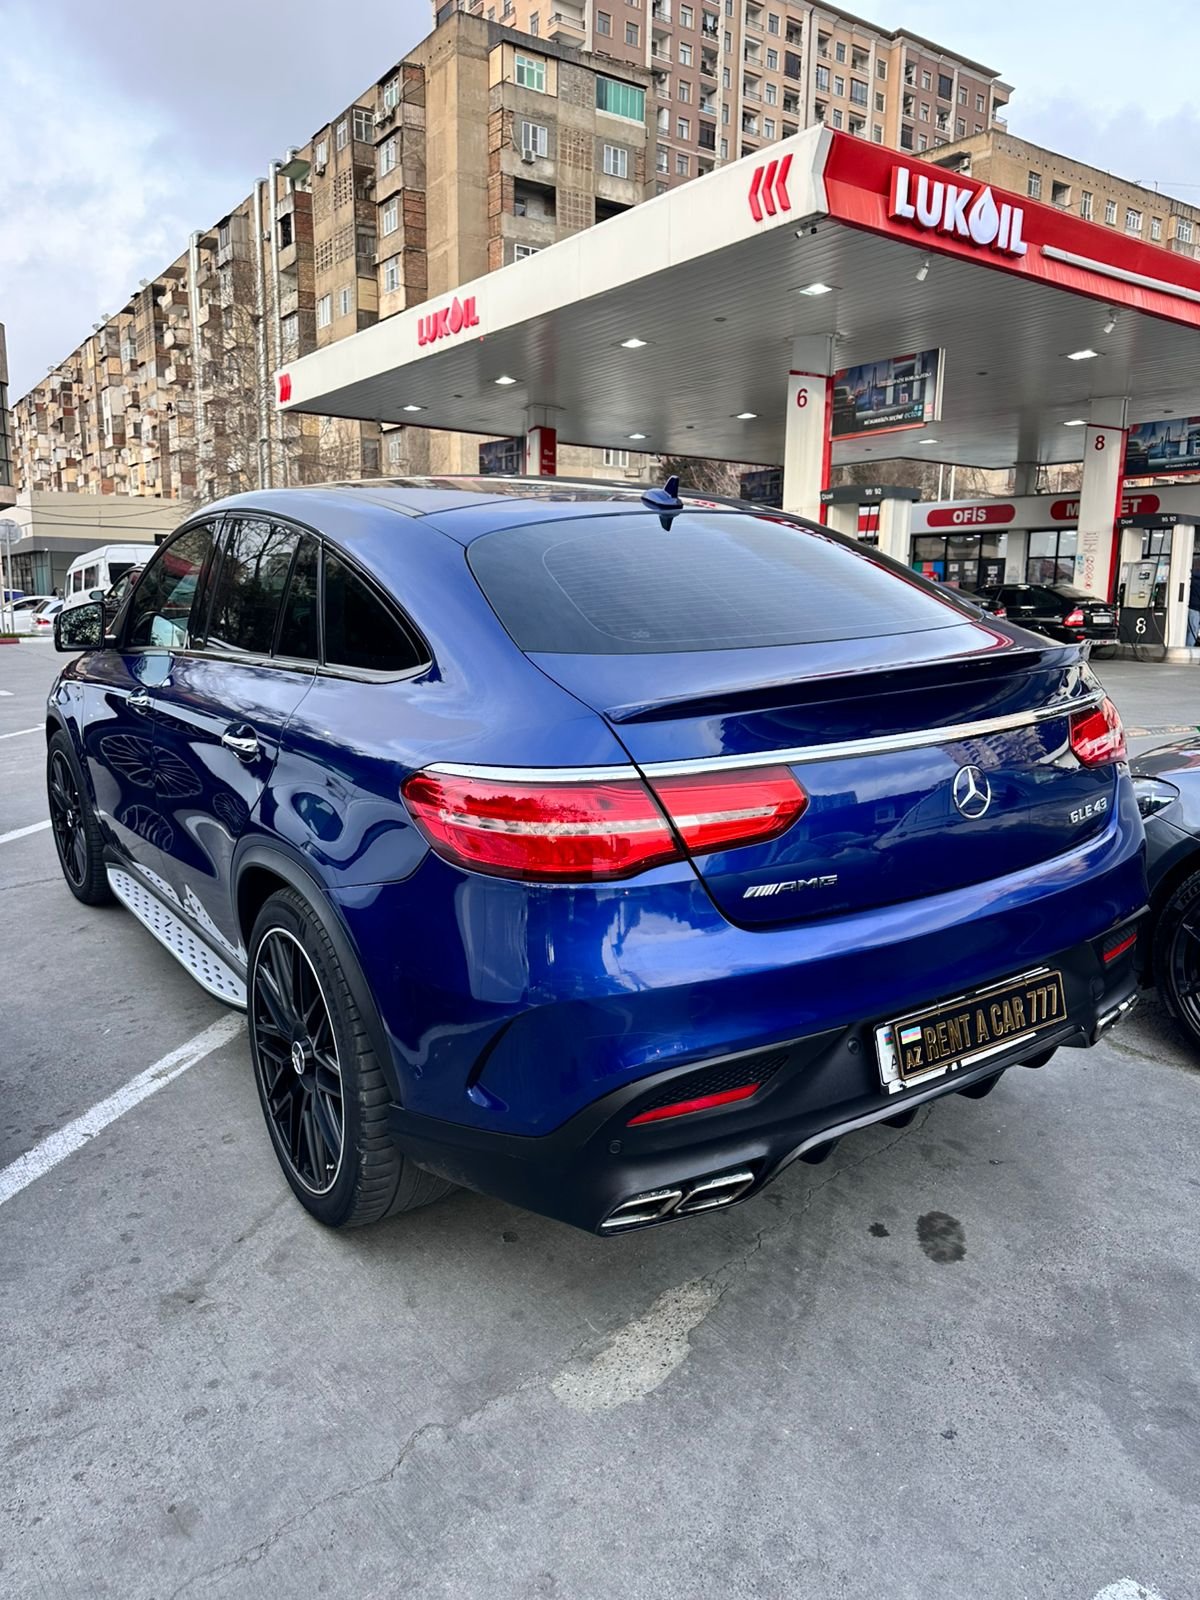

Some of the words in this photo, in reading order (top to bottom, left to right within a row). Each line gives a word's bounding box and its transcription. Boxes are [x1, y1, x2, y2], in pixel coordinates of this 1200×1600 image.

[890, 166, 1028, 257] LUKOIL
[417, 296, 480, 346] LUKOIL
[796, 387, 808, 408] 6
[1094, 434, 1105, 451] 8
[1135, 617, 1147, 634] 8
[1070, 804, 1092, 824] GLE
[1093, 797, 1107, 812] 43
[775, 874, 838, 894] AMG
[923, 1014, 971, 1062] RENT
[976, 1009, 990, 1044] A
[990, 996, 1026, 1037] CAR
[1026, 983, 1058, 1023] 777
[906, 1045, 923, 1069] AZ
